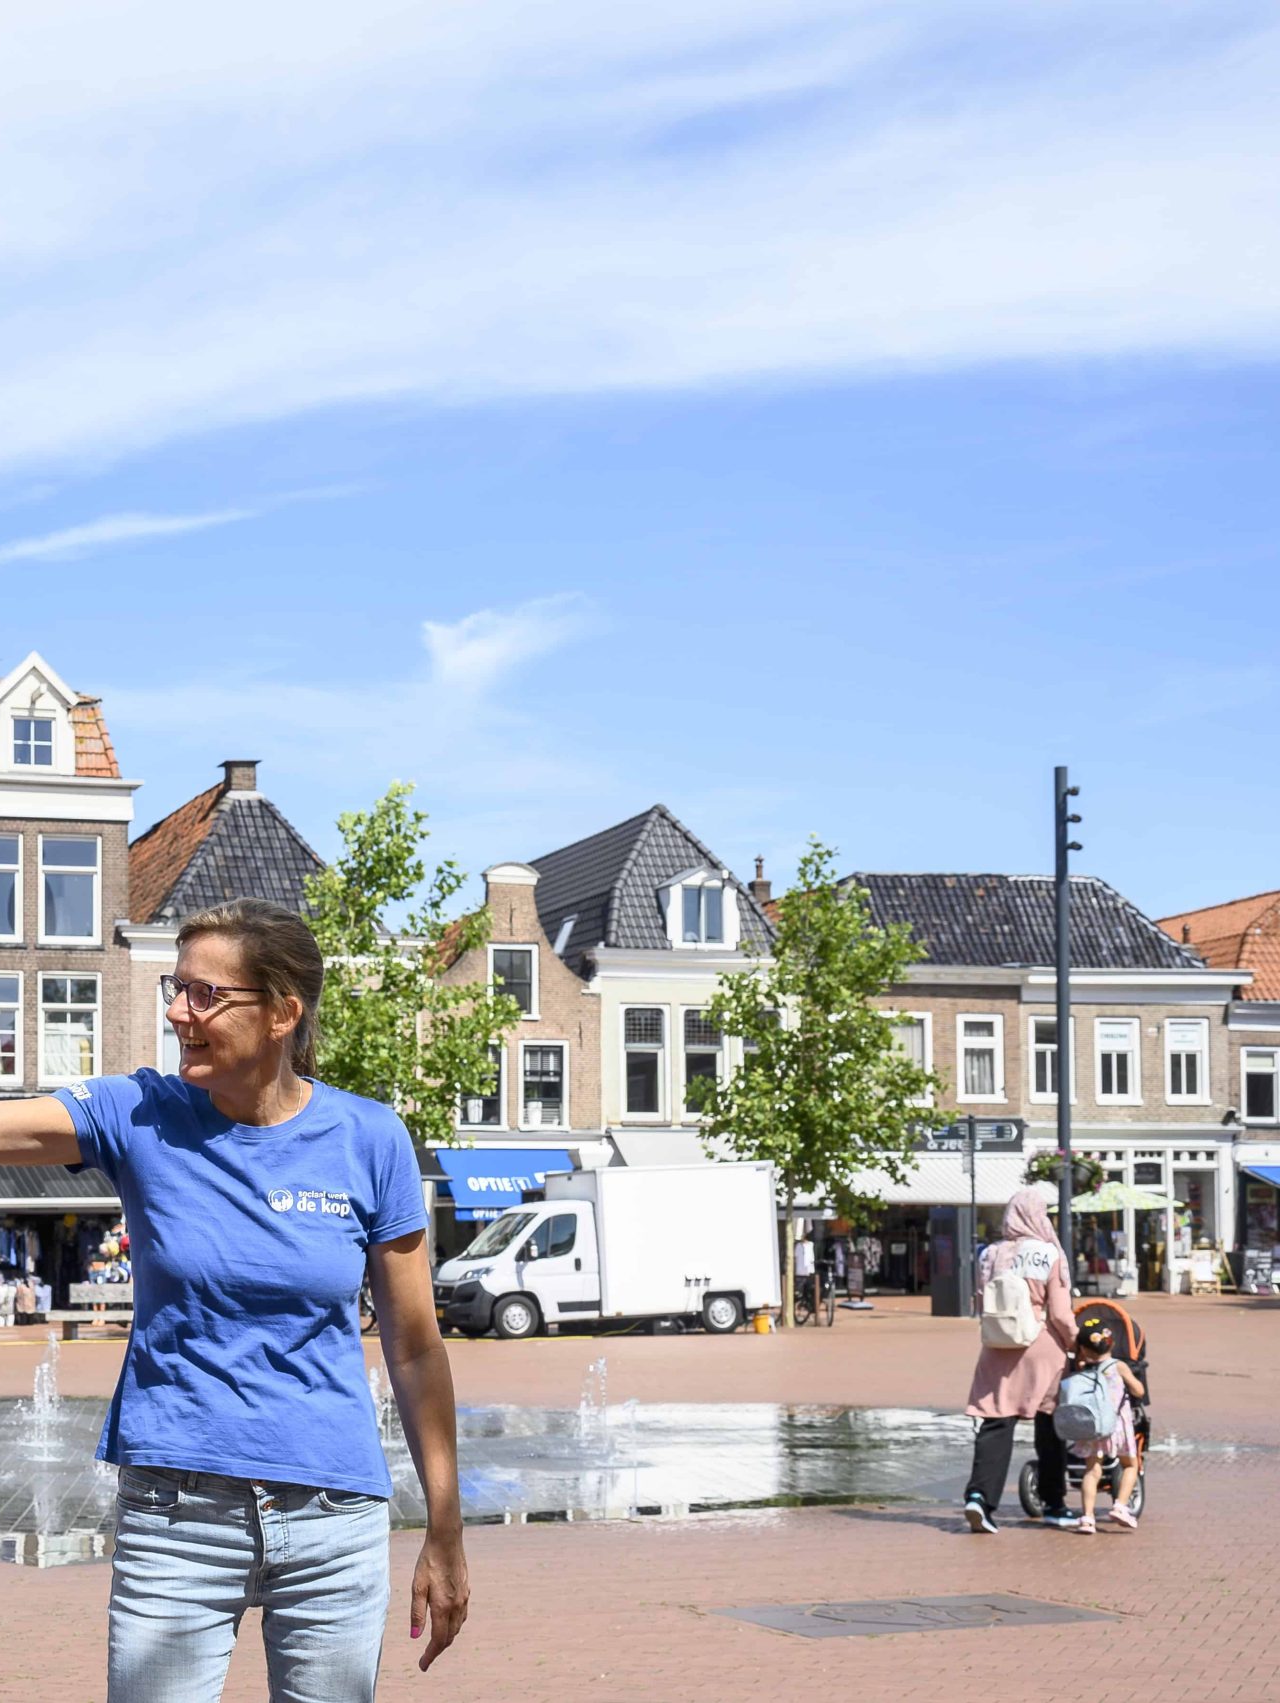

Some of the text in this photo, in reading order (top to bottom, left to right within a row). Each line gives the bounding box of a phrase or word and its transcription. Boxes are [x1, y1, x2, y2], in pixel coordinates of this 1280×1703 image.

[327, 1192, 349, 1201] werk
[296, 1196, 351, 1217] de kop
